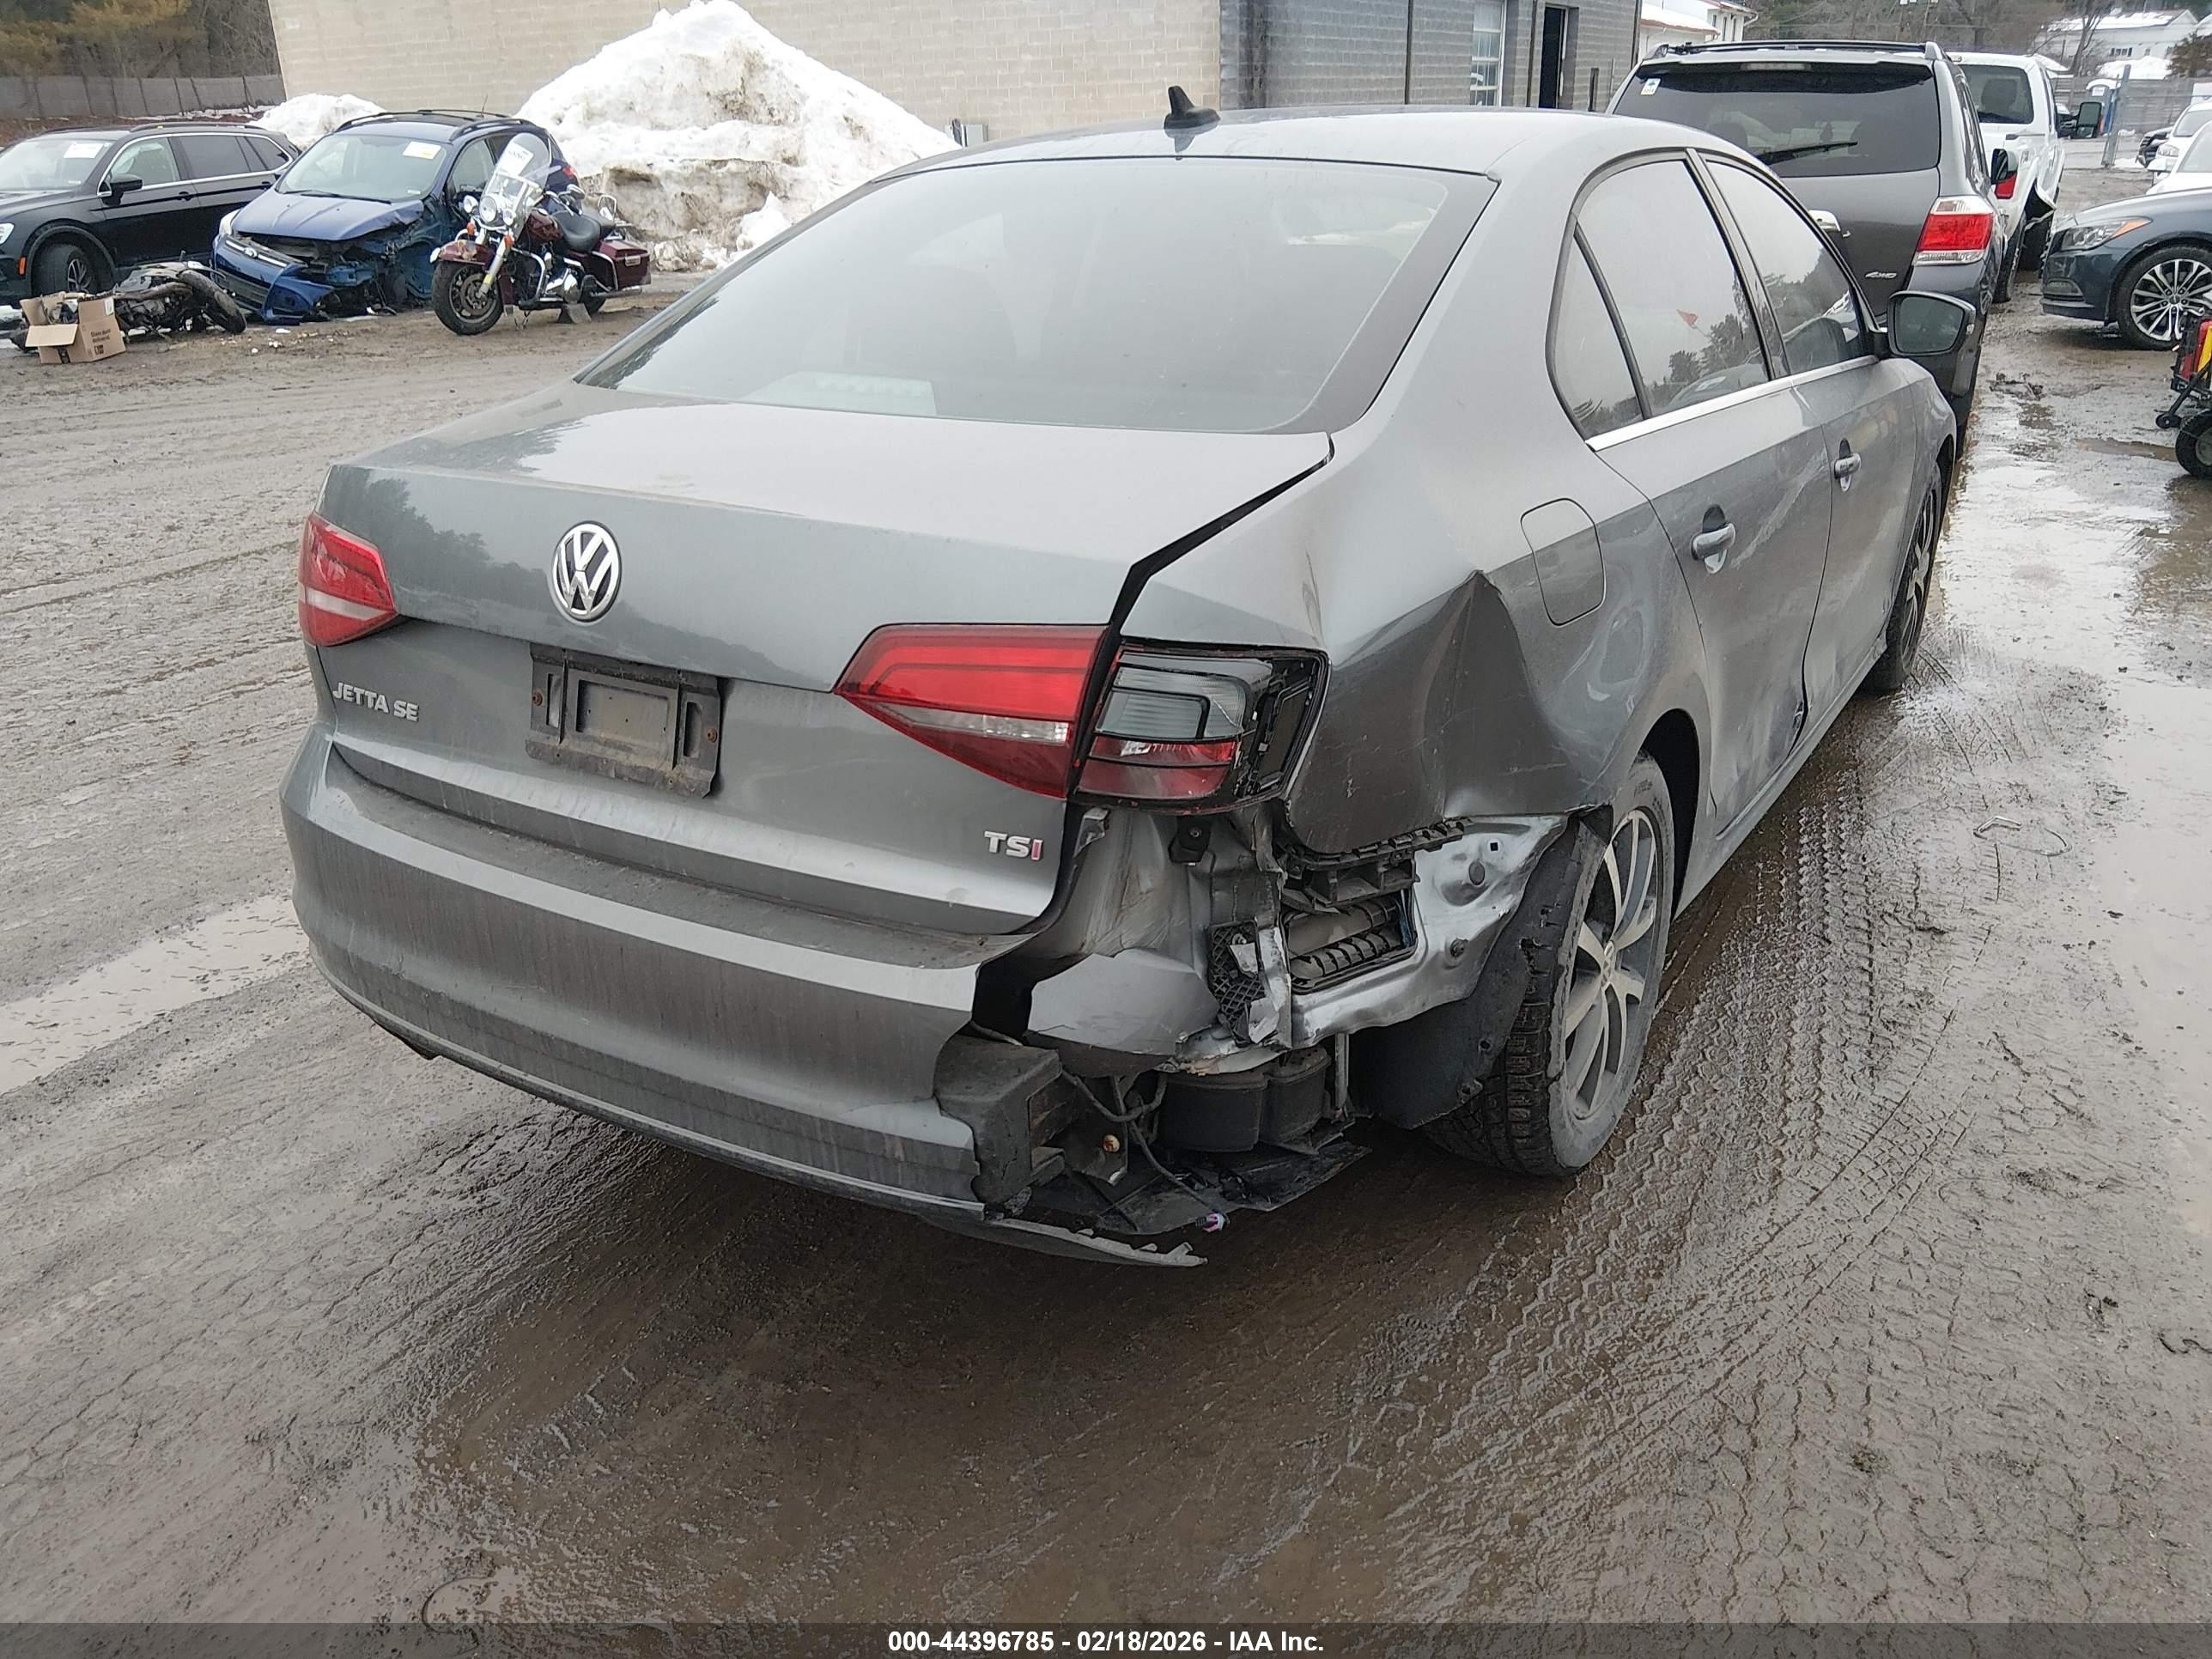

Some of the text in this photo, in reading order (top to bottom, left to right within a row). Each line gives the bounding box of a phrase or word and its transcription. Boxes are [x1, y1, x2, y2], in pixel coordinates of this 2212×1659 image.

[332, 682, 420, 722] JETTA SE
[983, 830, 1044, 861] TSI
